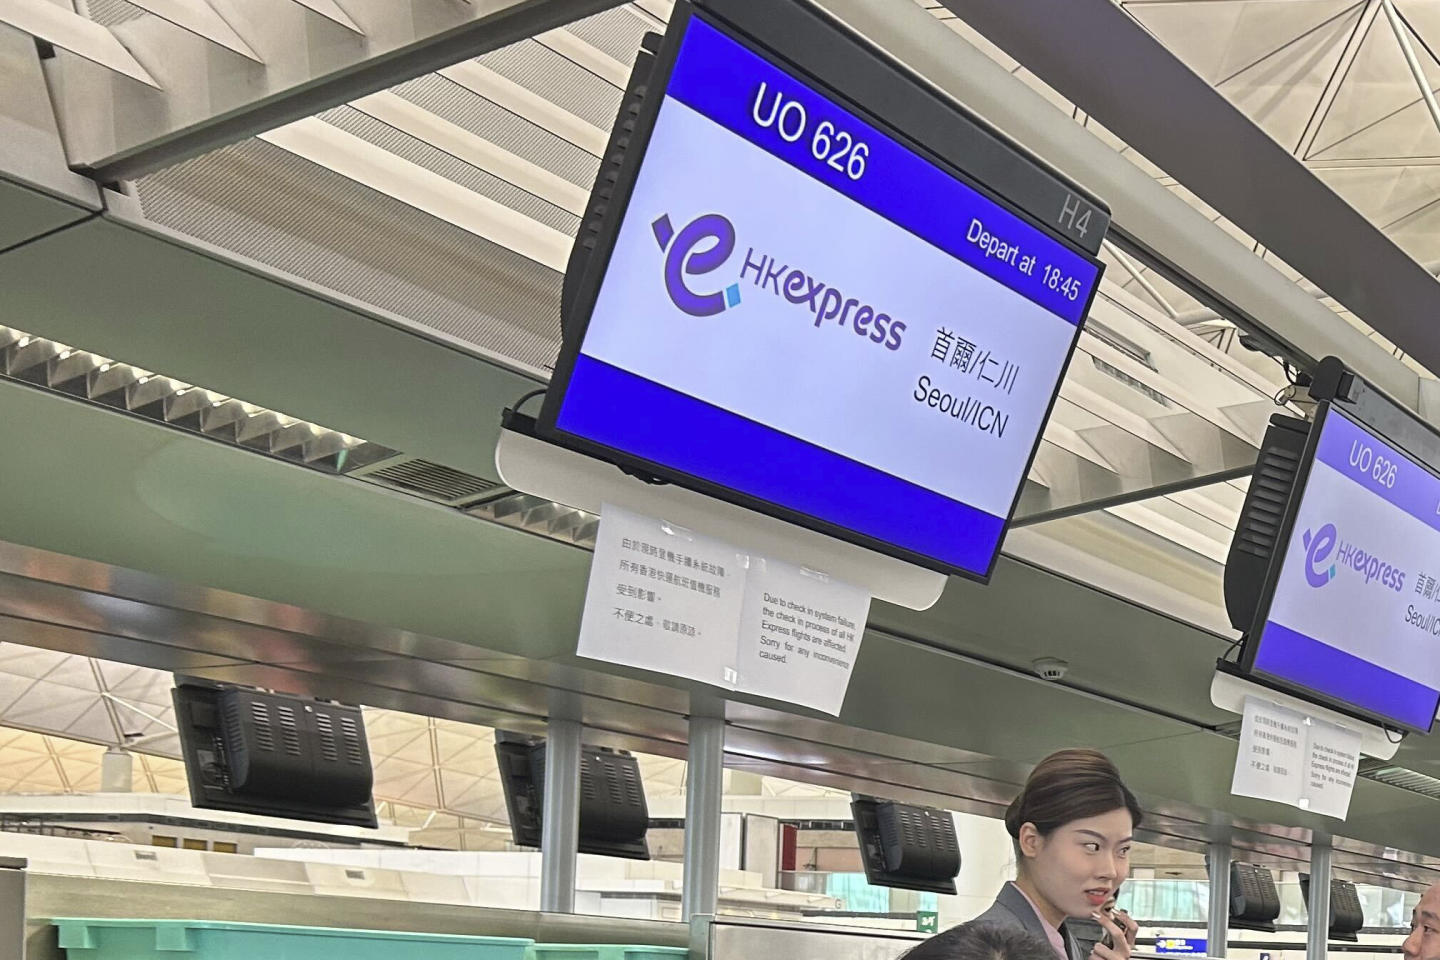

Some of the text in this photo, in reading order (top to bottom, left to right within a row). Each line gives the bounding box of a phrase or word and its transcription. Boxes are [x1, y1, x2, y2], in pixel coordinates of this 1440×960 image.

[753, 81, 869, 180] UO 626
[1058, 193, 1092, 238] H4
[967, 218, 1081, 301] Depart at 18:45
[931, 326, 1019, 395] 首爾/仁川
[914, 375, 1009, 438] Seoul/ICN
[1349, 439, 1398, 489] UO 626
[763, 607, 774, 617] the
[776, 611, 796, 623] check
[805, 621, 830, 633] process
[764, 592, 778, 604] Due
[780, 598, 786, 606] to
[787, 601, 806, 612] check
[807, 608, 813, 616] in
[815, 610, 837, 622] system
[760, 635, 780, 649] Sorry
[784, 641, 794, 651] for
[797, 647, 810, 658] any
[762, 620, 790, 635] Express
[792, 628, 810, 641] flights
[812, 636, 822, 645] are
